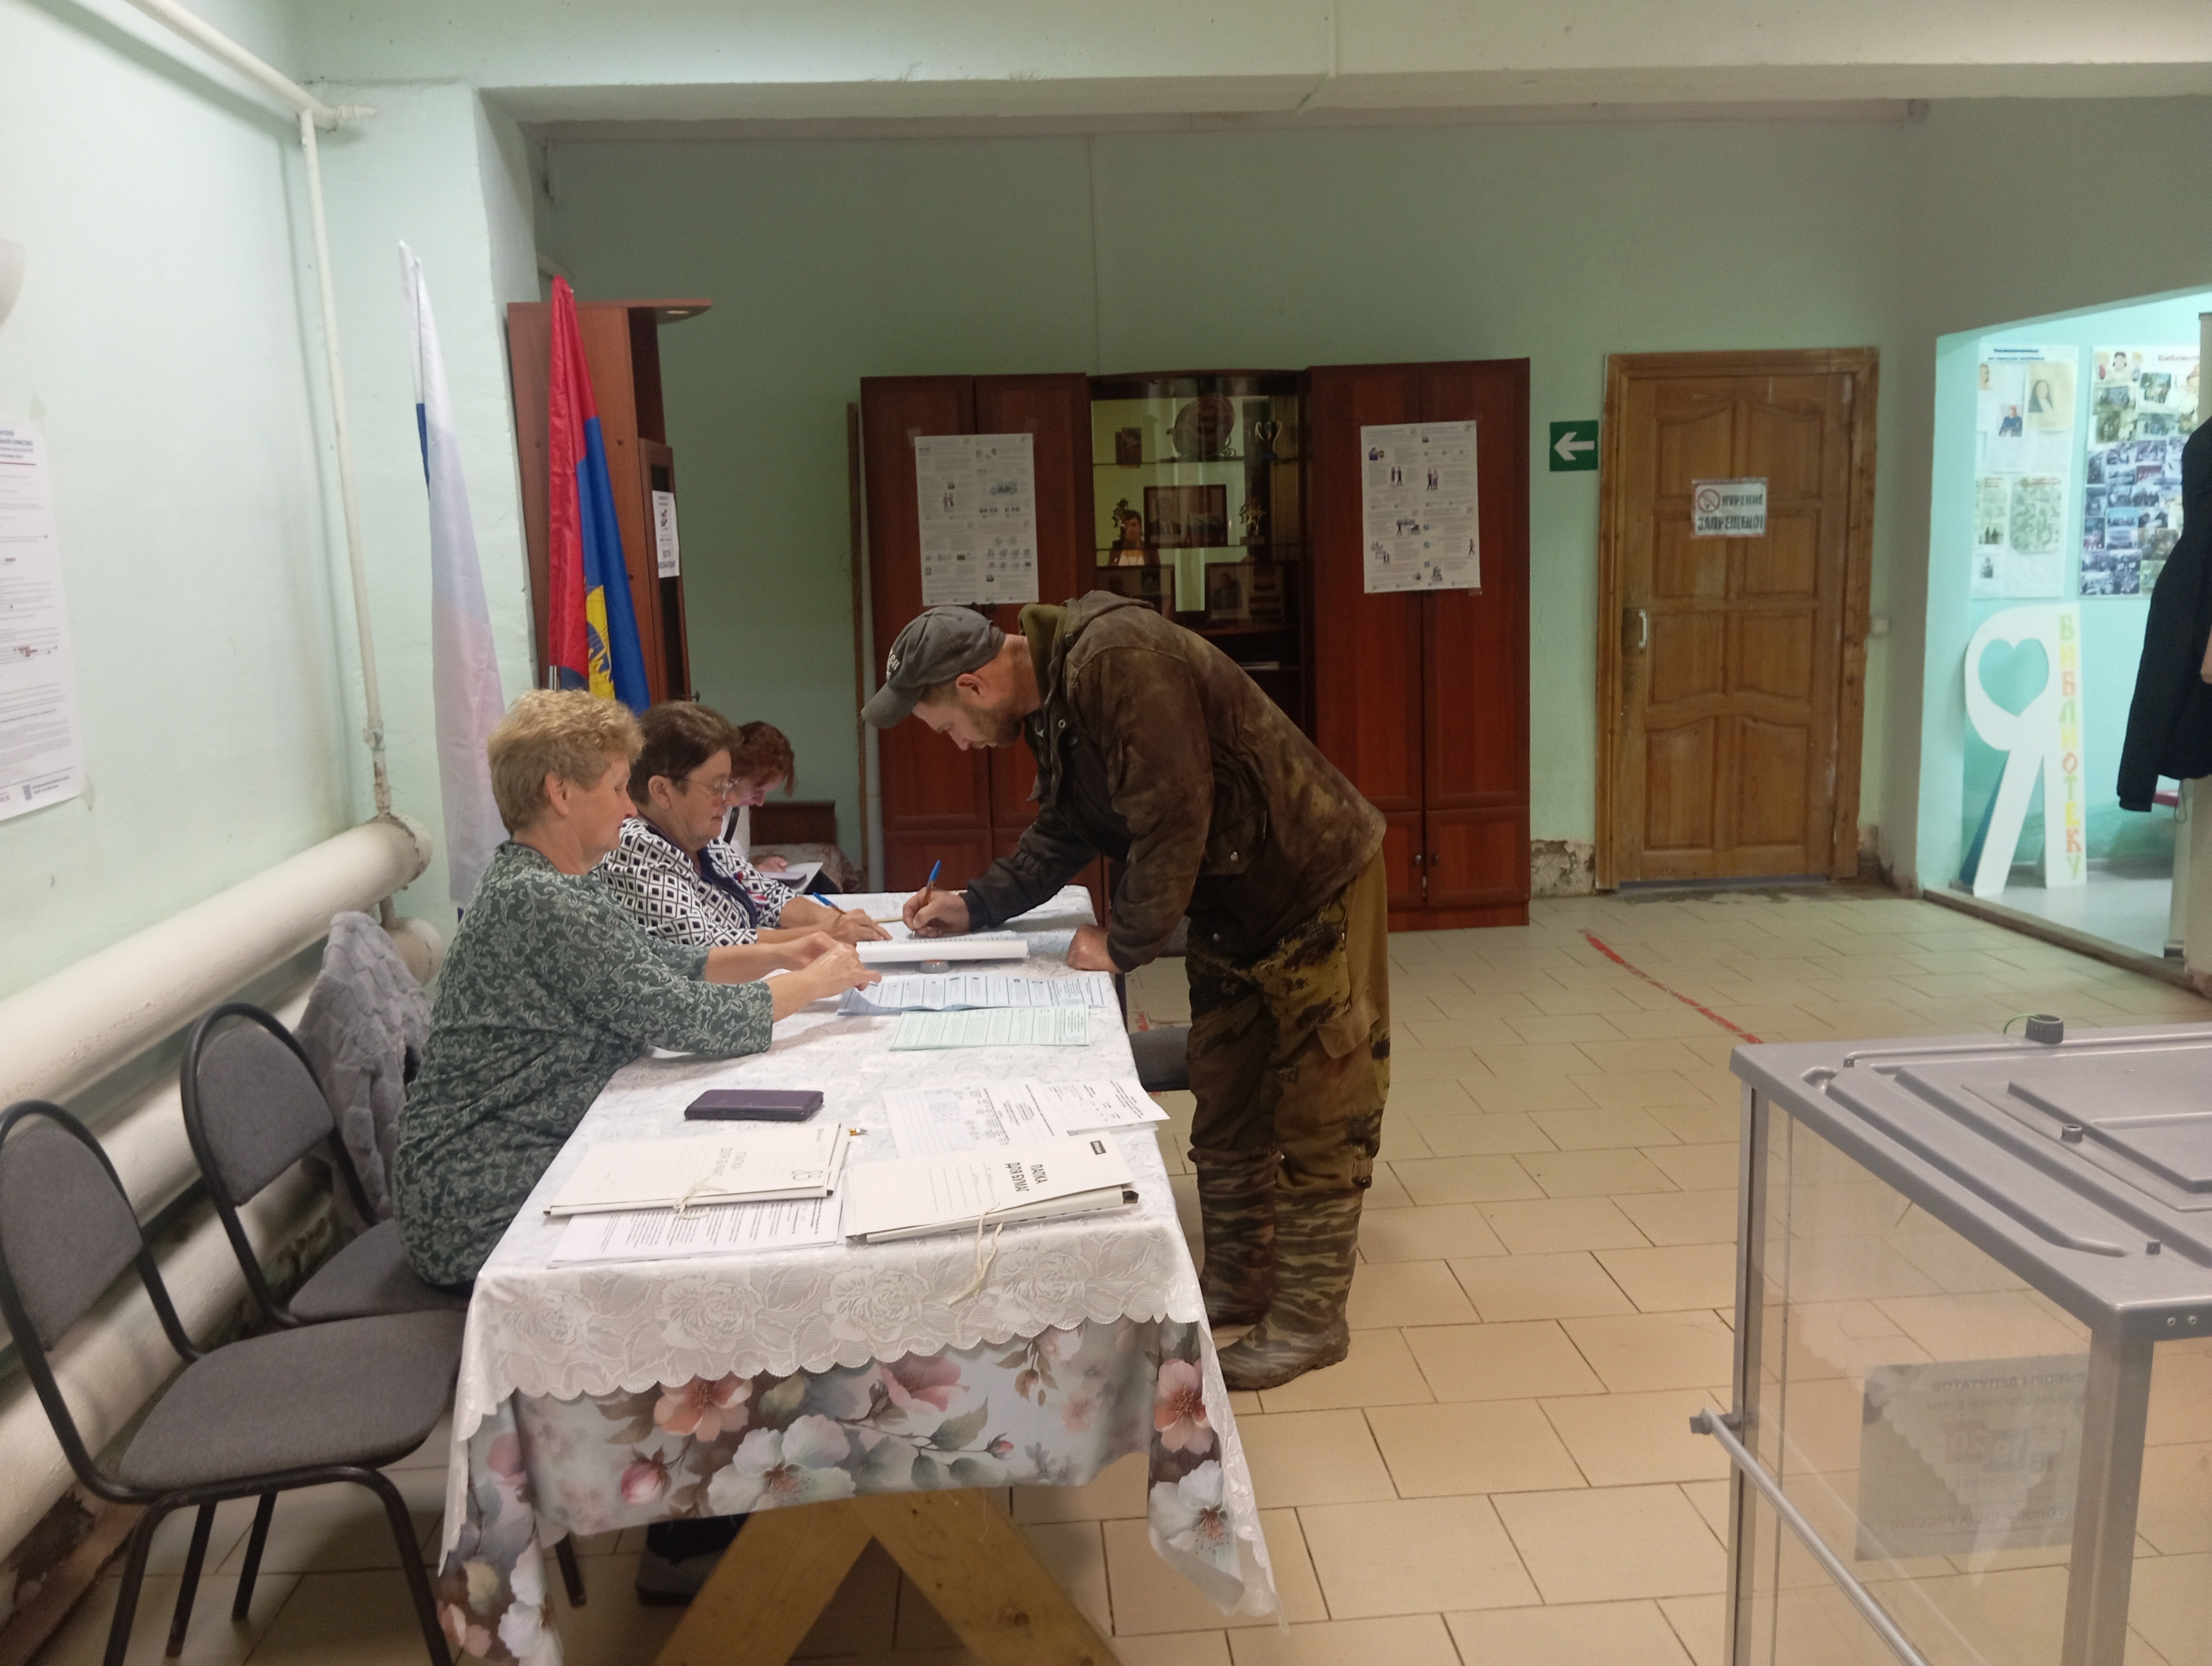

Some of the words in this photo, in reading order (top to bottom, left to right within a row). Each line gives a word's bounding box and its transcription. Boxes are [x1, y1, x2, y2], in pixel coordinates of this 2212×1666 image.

[1721, 494, 1763, 506] КУРЕНИЕ
[1965, 603, 2087, 898] Я
[2059, 614, 2082, 881] БИБЛИОТЕКУ
[1005, 1162, 1023, 1175] ДЛЯ
[1030, 1164, 1048, 1184] ПАПКА
[1012, 1174, 1030, 1192] БУМАГ
